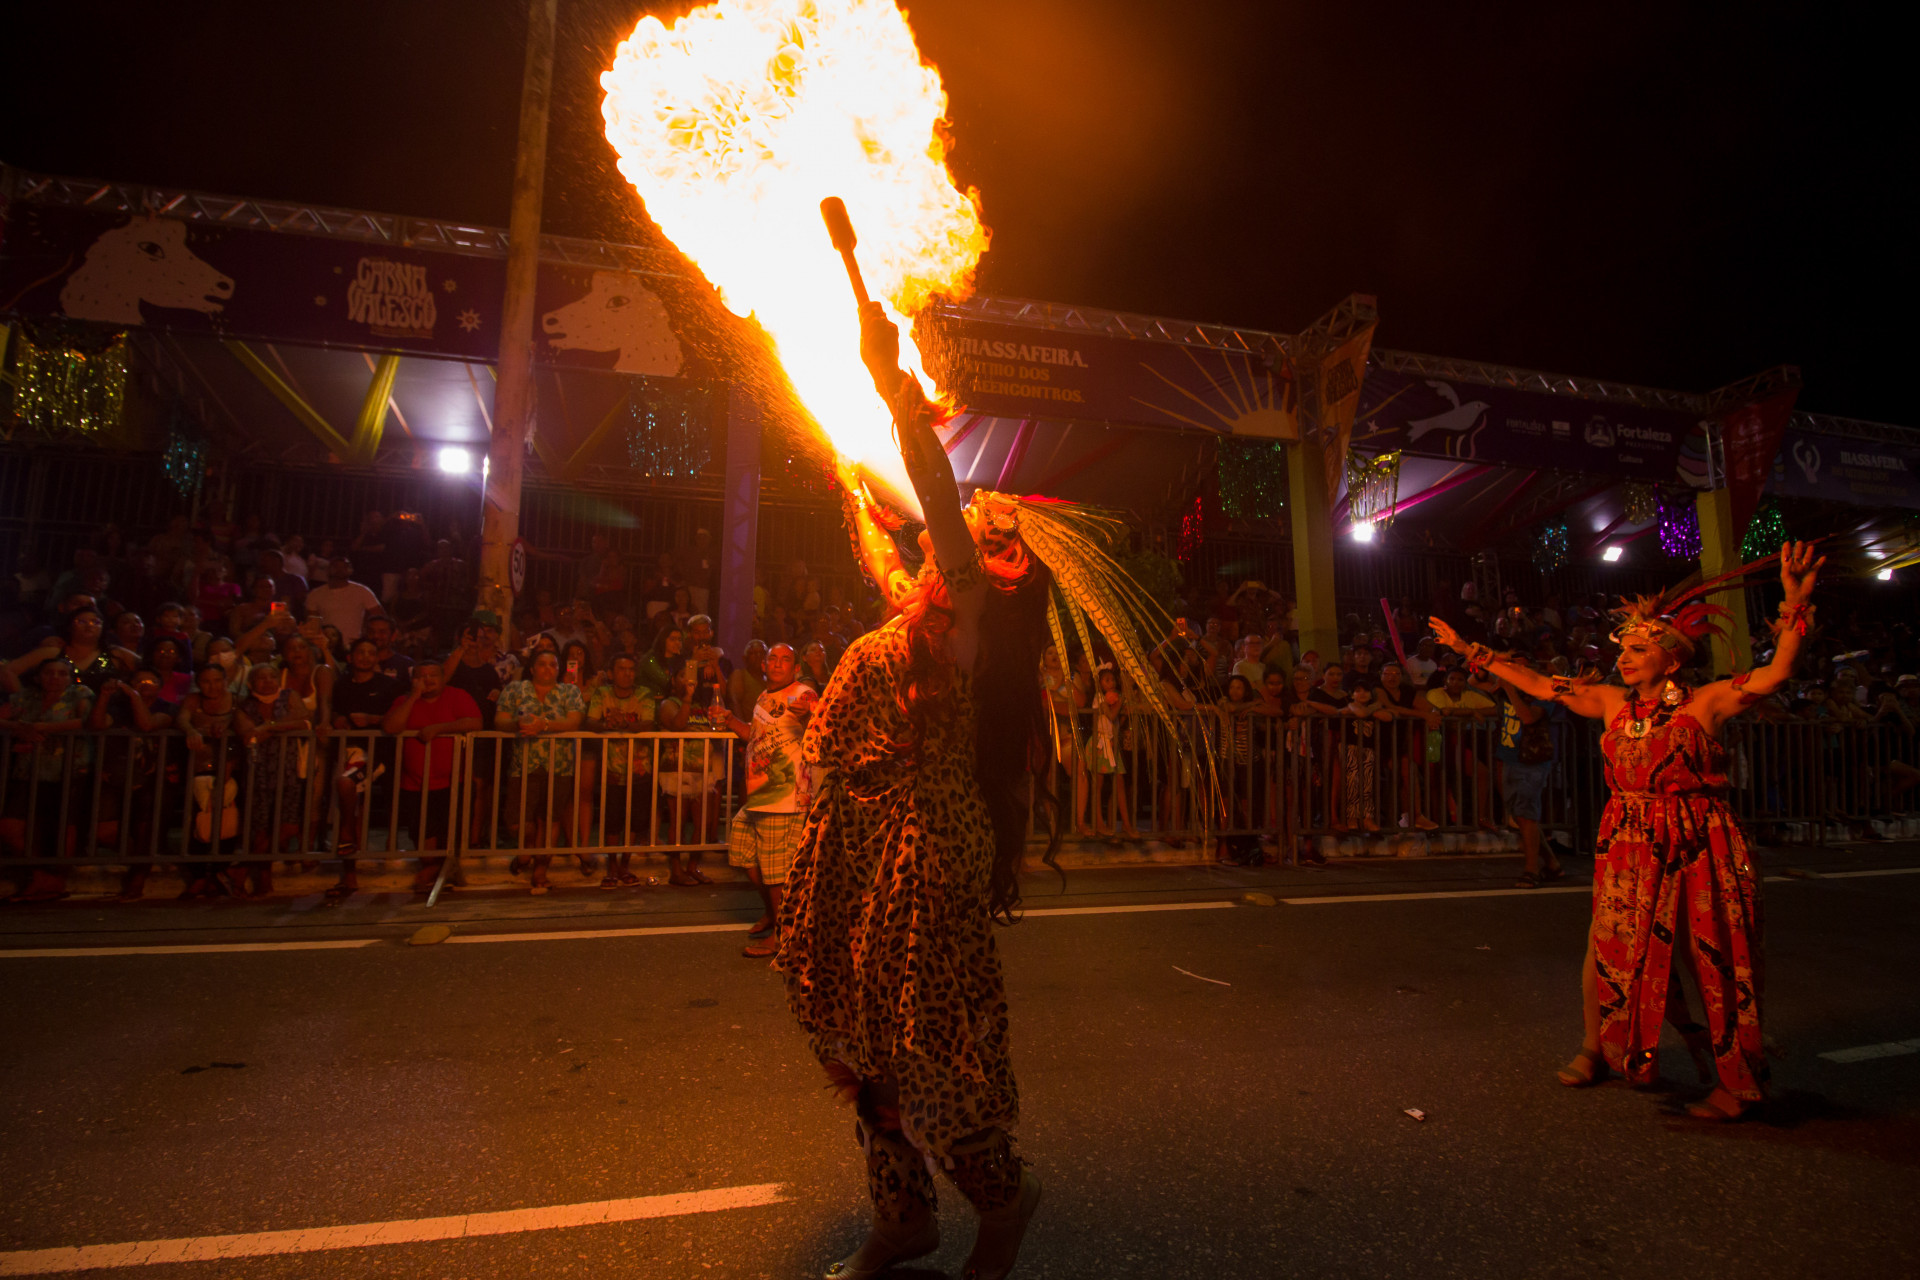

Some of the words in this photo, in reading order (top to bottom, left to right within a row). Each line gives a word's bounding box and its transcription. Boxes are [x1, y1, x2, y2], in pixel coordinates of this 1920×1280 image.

[357, 257, 428, 298] CARNA
[347, 279, 437, 329] VALESCO
[1019, 366, 1050, 381] DOS
[1616, 423, 1672, 443] Fortaleza
[514, 549, 523, 576] 50
